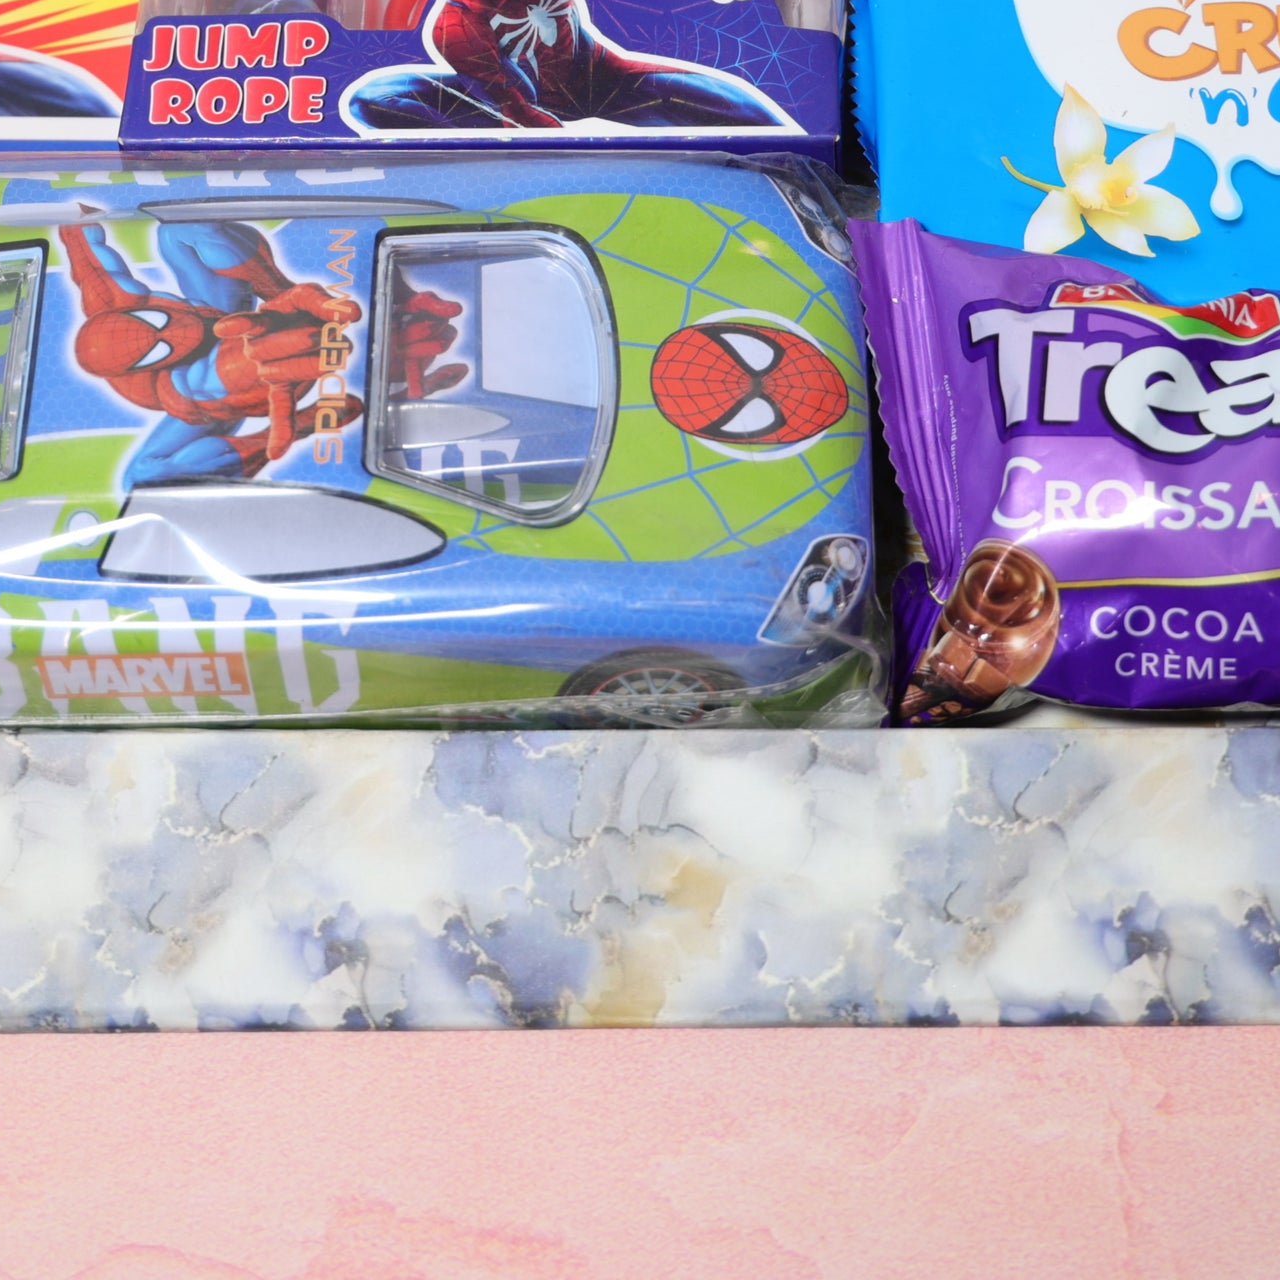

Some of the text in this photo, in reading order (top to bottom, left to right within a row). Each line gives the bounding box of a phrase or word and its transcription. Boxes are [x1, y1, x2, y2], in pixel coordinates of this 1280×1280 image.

[143, 20, 330, 71] JUMP
[149, 76, 327, 124] ROPE
[313, 228, 357, 465] SPIDER-MAN
[1090, 606, 1264, 643] COCOA
[42, 655, 247, 696] MARVEL
[1115, 647, 1238, 681] CRÈME
